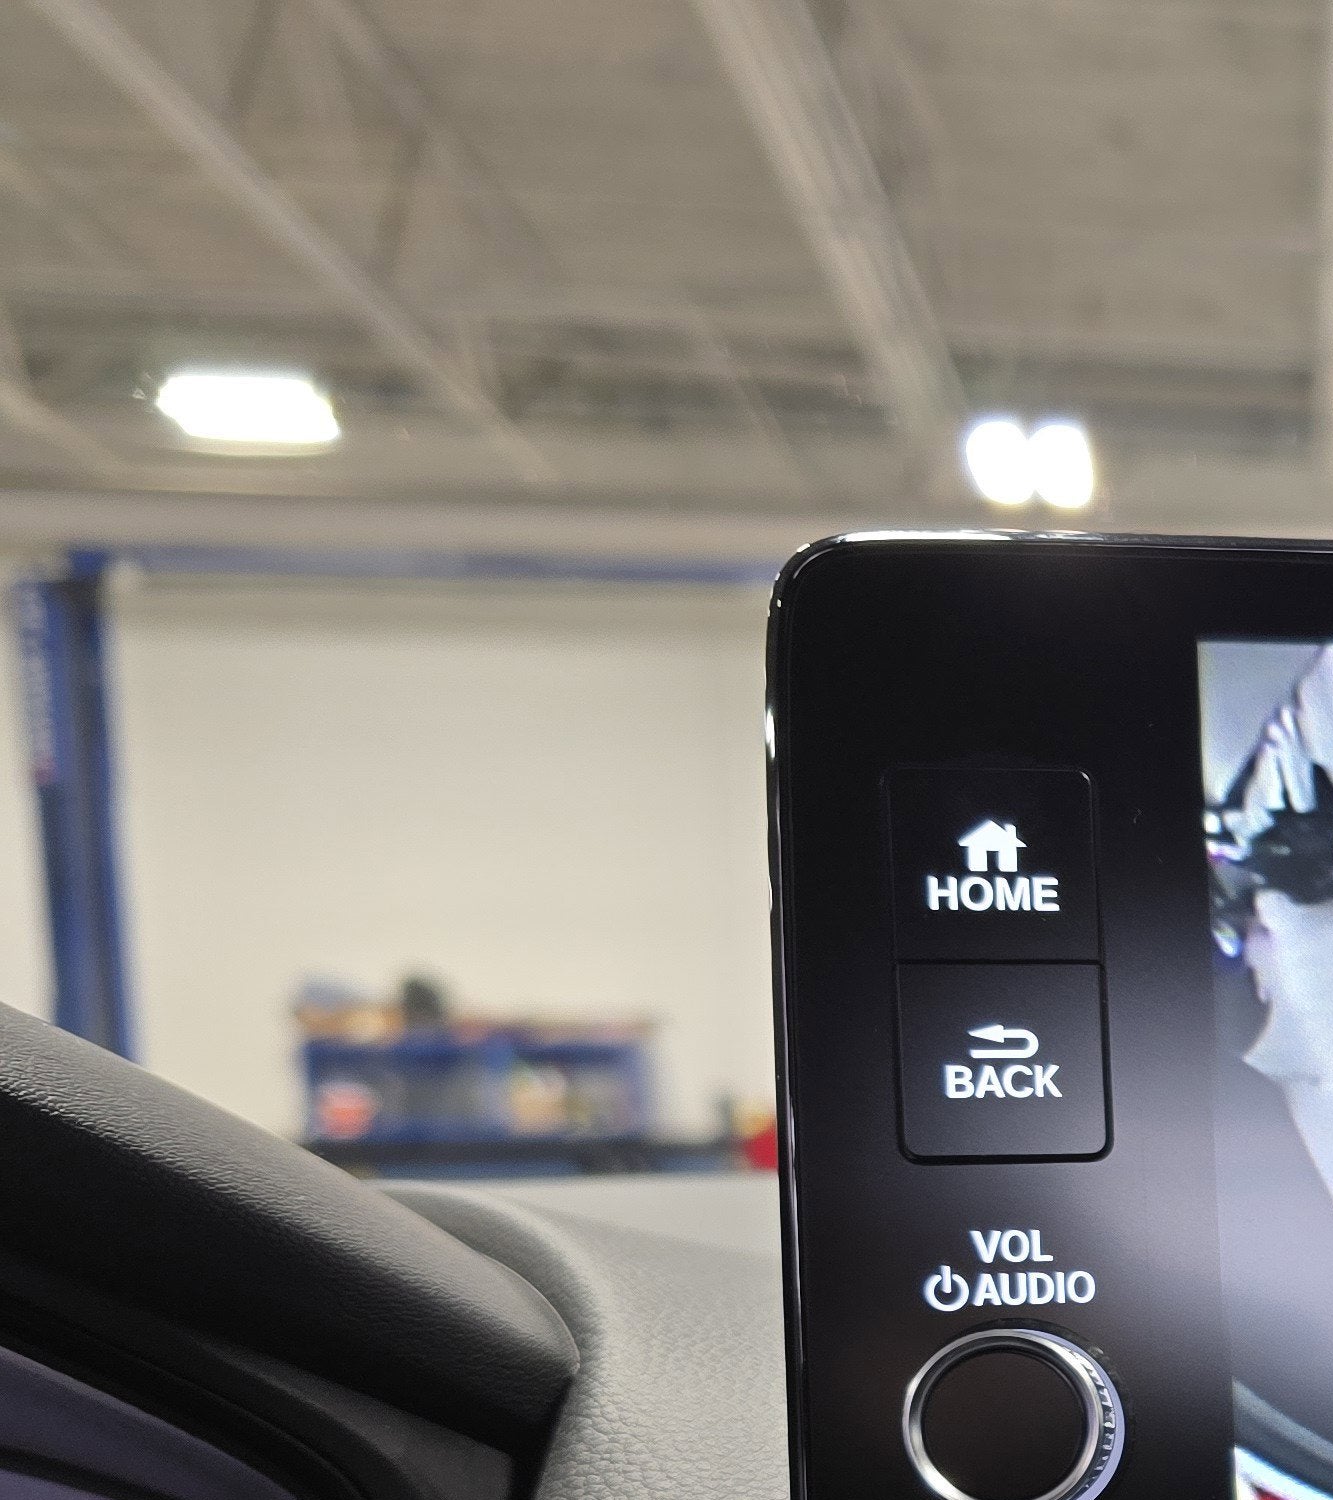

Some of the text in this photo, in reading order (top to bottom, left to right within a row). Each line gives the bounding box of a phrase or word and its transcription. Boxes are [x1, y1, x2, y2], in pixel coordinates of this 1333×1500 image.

[928, 875, 1060, 911] HOME
[945, 1063, 1062, 1098] BACK
[970, 1229, 1053, 1263] VOL
[973, 1271, 1095, 1306] AUDIO
